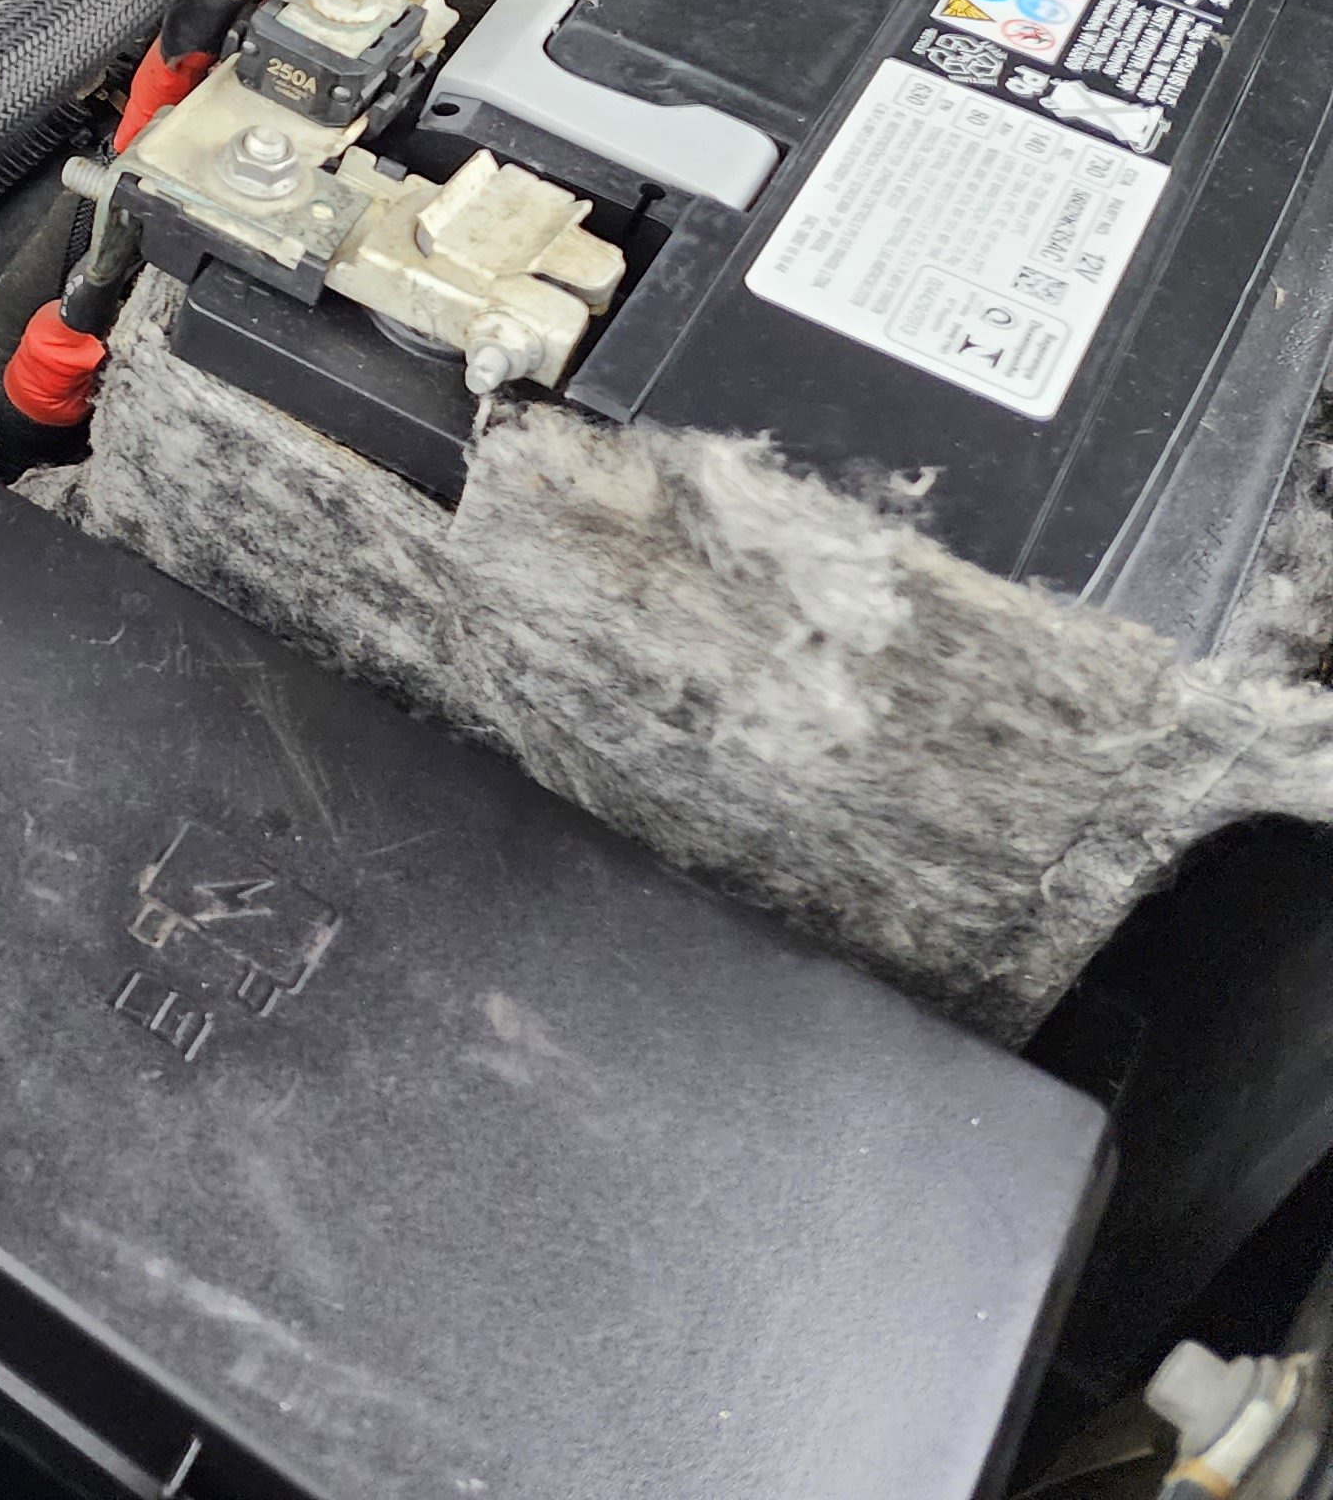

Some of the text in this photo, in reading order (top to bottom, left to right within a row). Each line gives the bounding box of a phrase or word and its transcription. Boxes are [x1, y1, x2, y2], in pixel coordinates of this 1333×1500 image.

[1171, 52, 1199, 74] FCA
[266, 57, 318, 96] 250A
[1005, 65, 1051, 99] Pb
[1164, 71, 1189, 87] US
[903, 80, 934, 107] 630
[1155, 84, 1183, 106] LLC
[964, 107, 991, 127] 80
[1021, 129, 1052, 155] 140
[1082, 151, 1114, 180] 730
[1069, 247, 1109, 285] 12V
